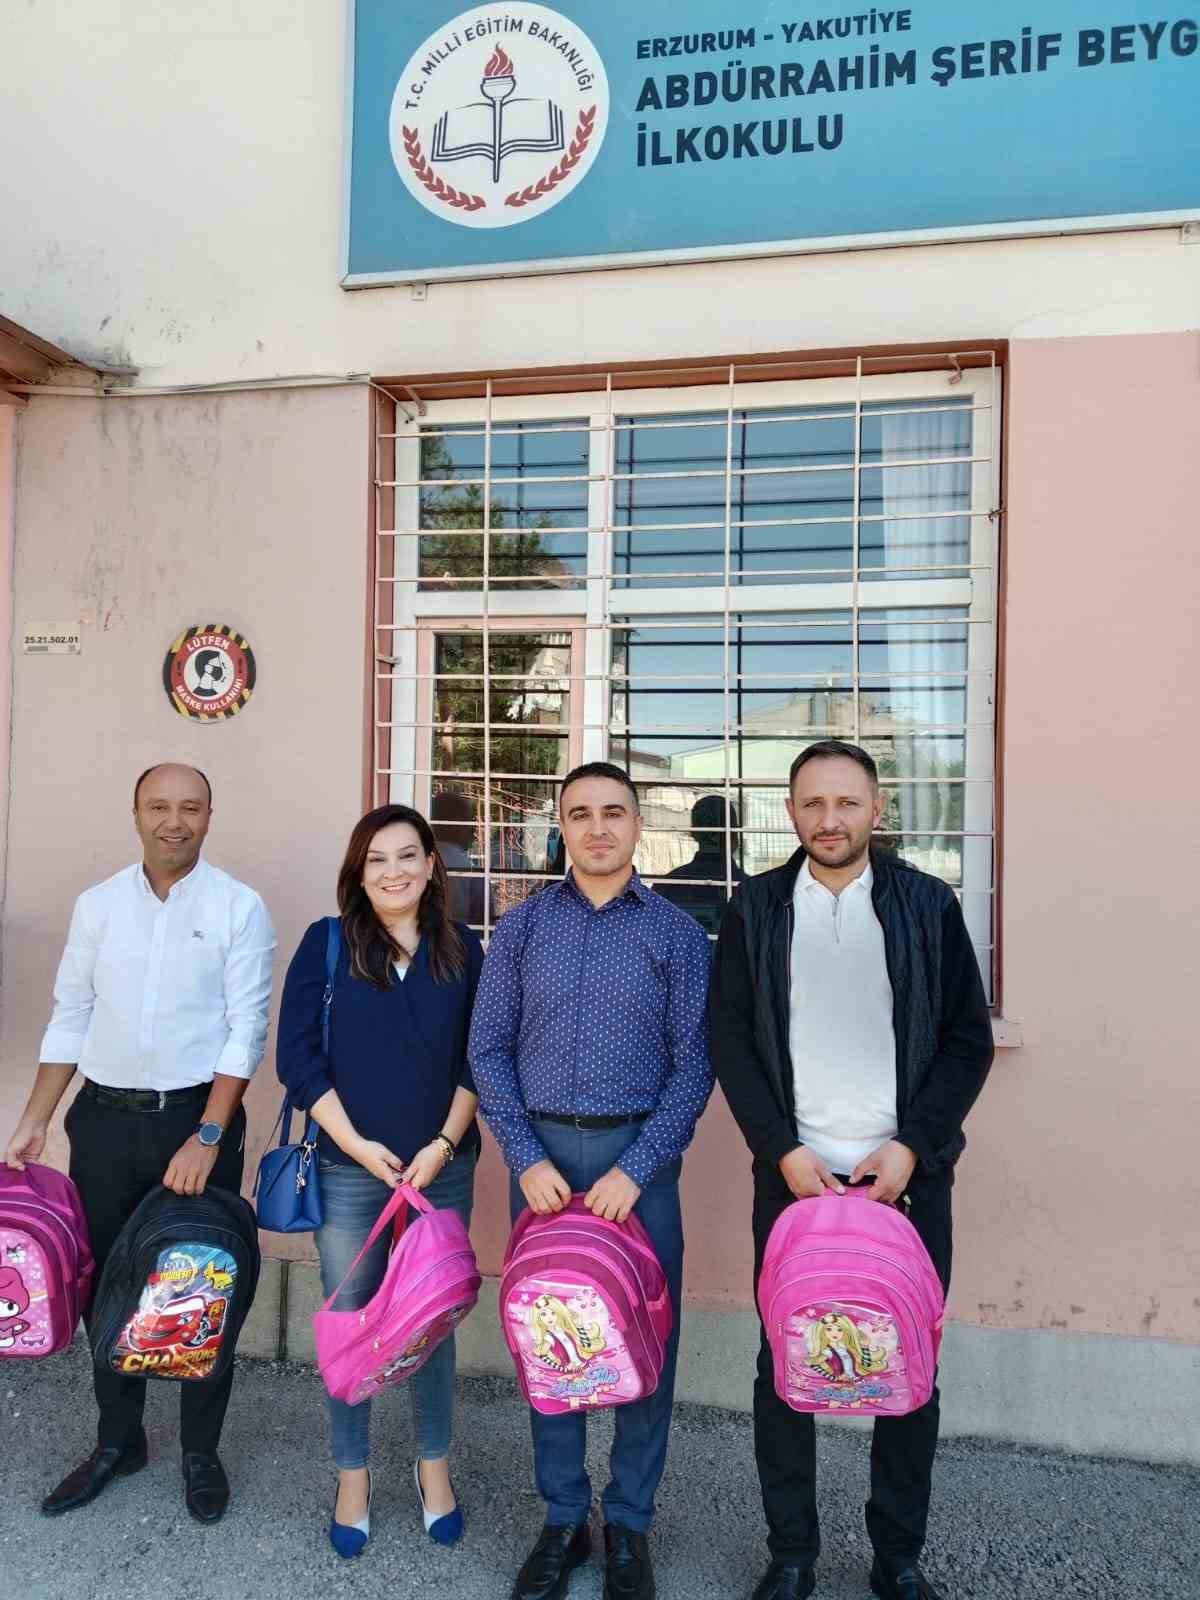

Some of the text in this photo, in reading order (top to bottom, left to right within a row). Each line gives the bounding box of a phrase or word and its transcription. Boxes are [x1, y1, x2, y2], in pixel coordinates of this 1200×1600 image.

[636, 28, 756, 60] ERZURUM
[781, 8, 912, 44] YAKUTİYE
[405, 15, 593, 110] T.C. MİLLİ EĞİTİM BAKANLIĞI
[635, 19, 1199, 112] ABDÜRRAHİM ŞERİF BEYG
[636, 113, 844, 168] İLKOKULU
[24, 636, 79, 644] 25.21.502.01
[186, 635, 230, 652] LÜTFEN
[175, 685, 201, 711] MASKE
